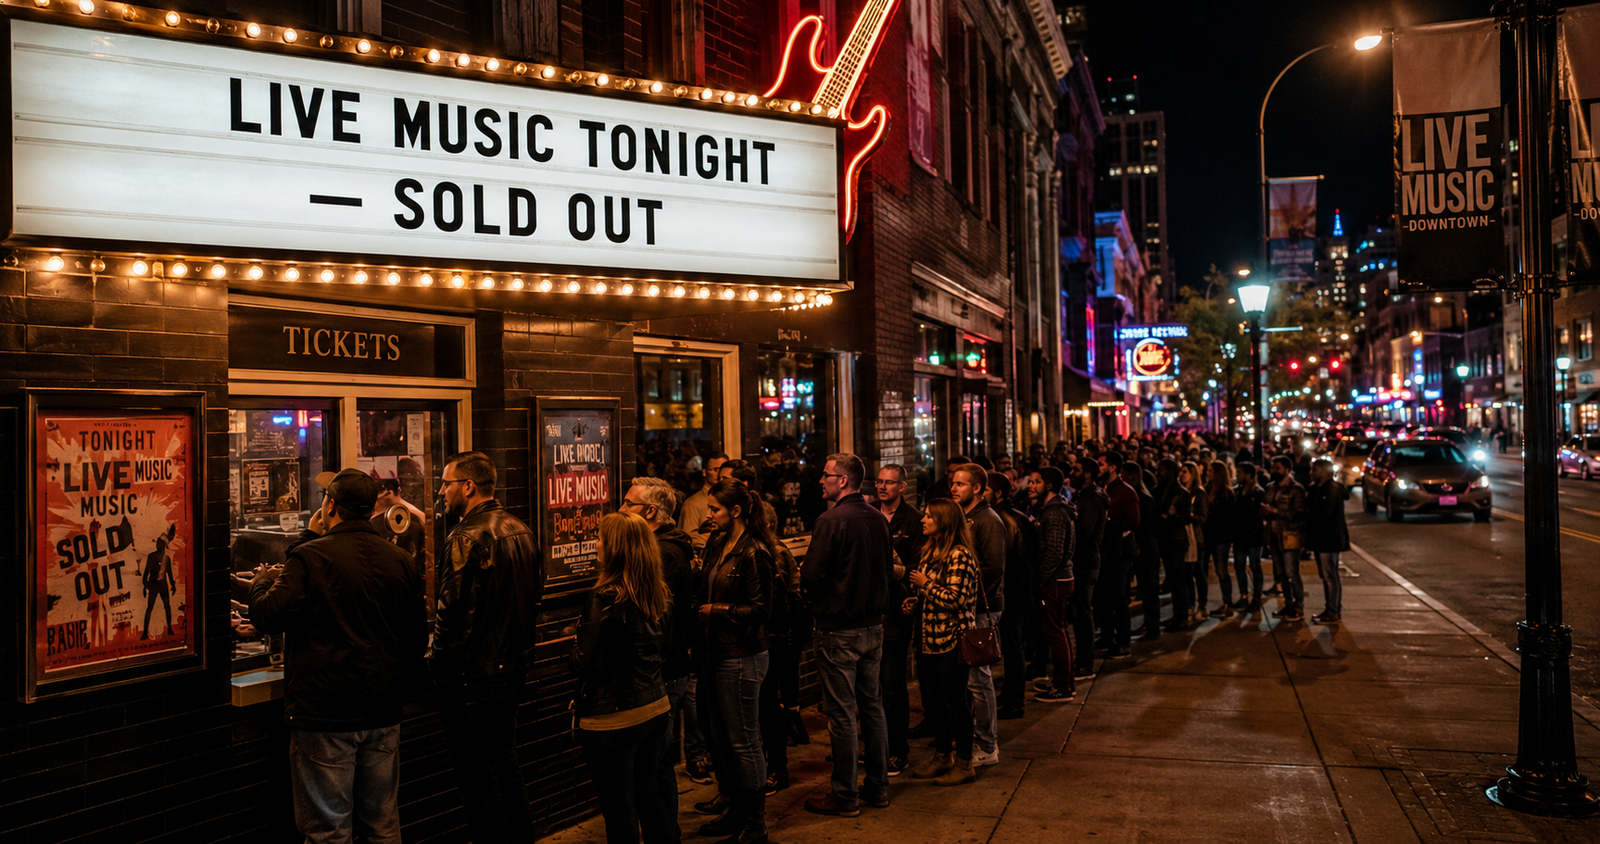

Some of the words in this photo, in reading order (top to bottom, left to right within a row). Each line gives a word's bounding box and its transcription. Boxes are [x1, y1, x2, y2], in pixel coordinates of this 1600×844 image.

[230, 78, 362, 143] LIVE
[394, 98, 555, 163] MUSIC
[580, 120, 776, 185] TONIGHT
[1402, 113, 1491, 172] LIVE
[395, 178, 537, 237] SOLD
[569, 193, 664, 246] OUT
[1402, 169, 1495, 216] MUSIC
[282, 325, 400, 361] TICKETS
[79, 430, 156, 452] TONIGHT
[63, 460, 131, 492] LIVE
[134, 458, 173, 482] MUSIC
[549, 477, 573, 505] LIVE
[576, 474, 607, 502] MUSIC
[81, 493, 138, 518] MUSIC
[56, 525, 126, 569] SOLD
[74, 560, 125, 602] OUT
